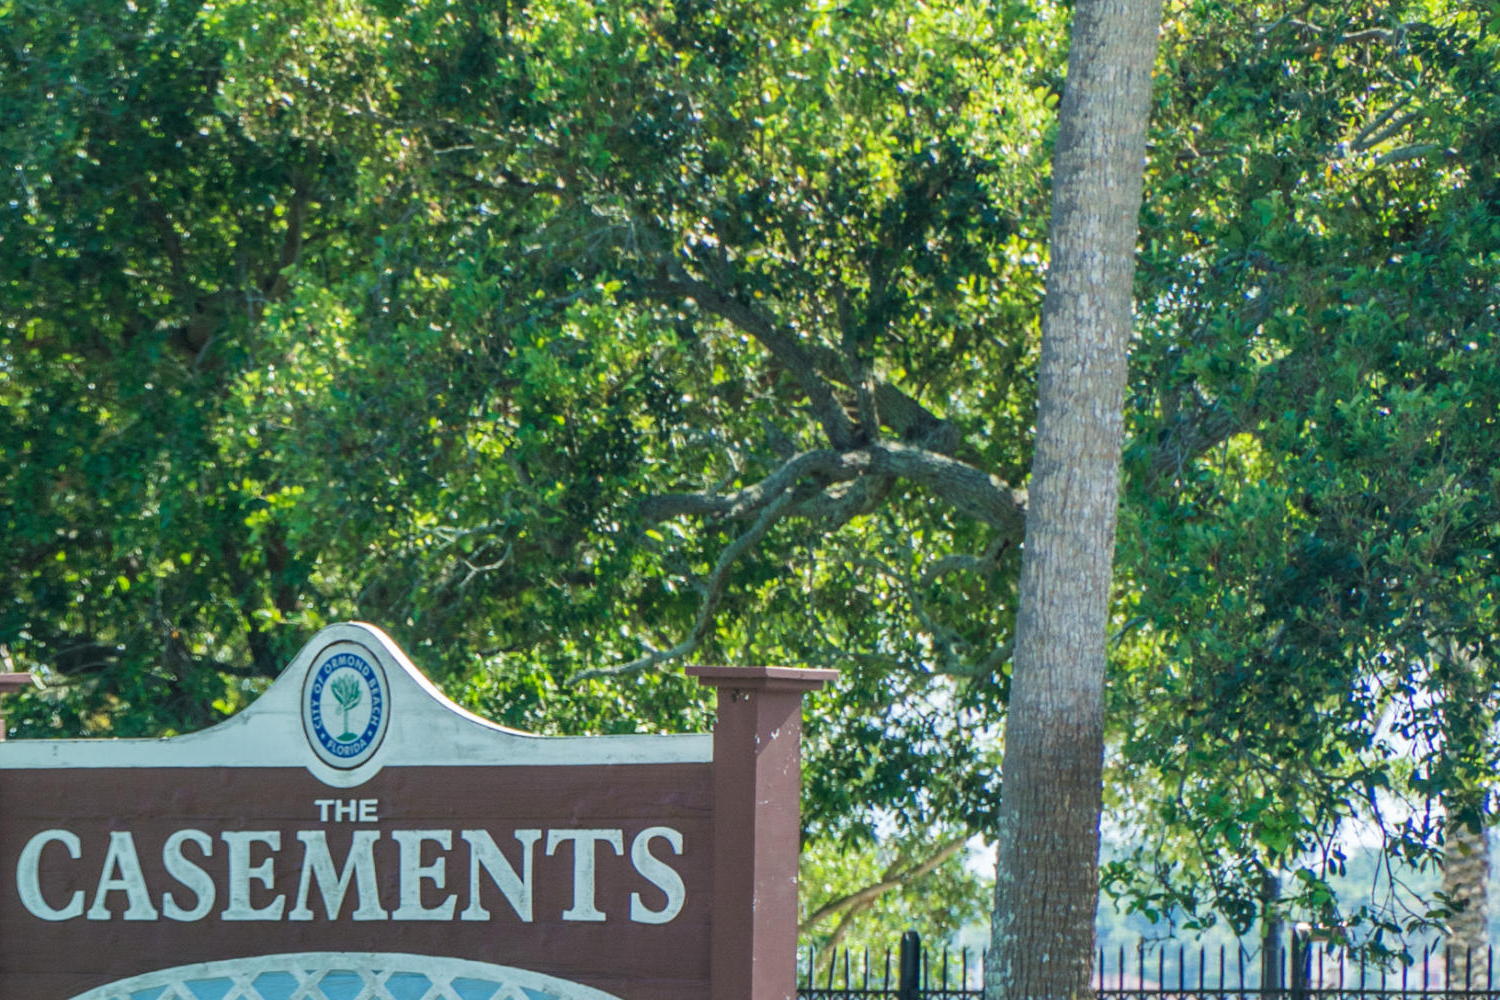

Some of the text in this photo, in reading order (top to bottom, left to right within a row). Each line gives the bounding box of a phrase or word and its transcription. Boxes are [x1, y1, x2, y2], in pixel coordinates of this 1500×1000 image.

[310, 655, 381, 729] CITY OF ORMOND BEACH
[326, 739, 367, 755] FLORIDA
[314, 799, 378, 822] THE
[16, 826, 686, 924] CASEMENTS
